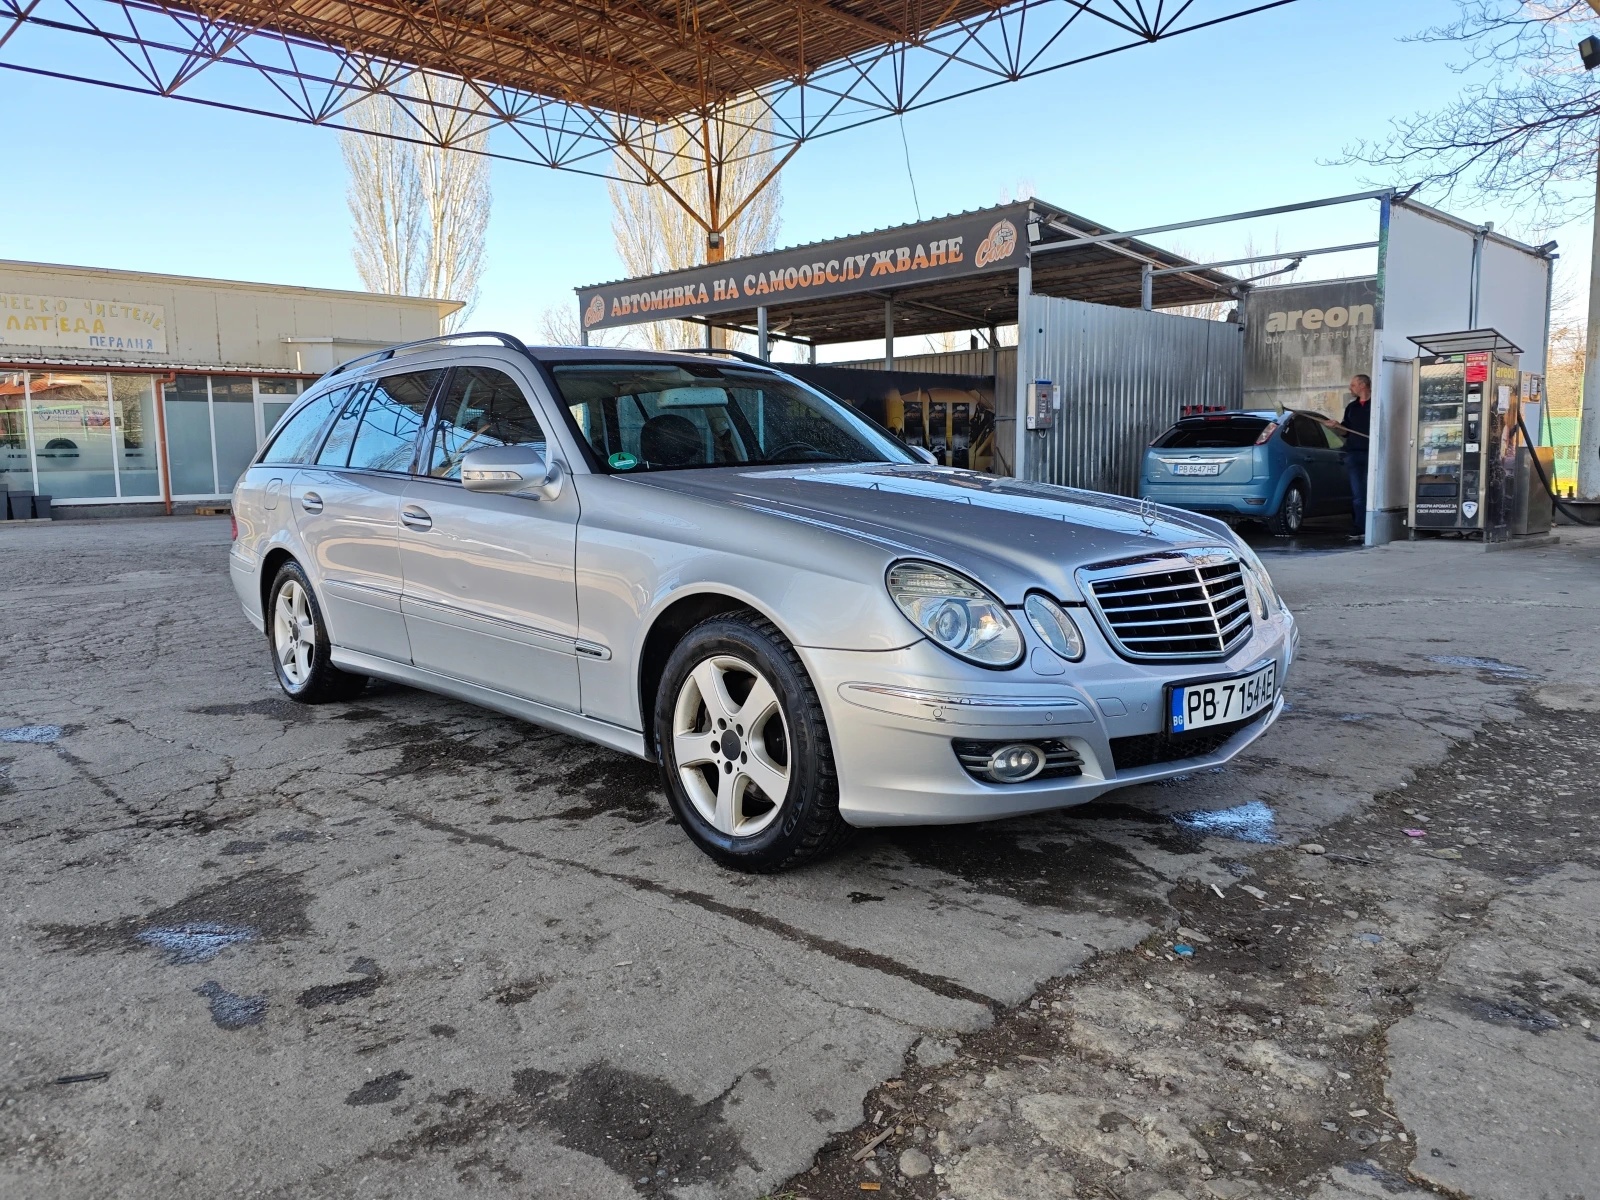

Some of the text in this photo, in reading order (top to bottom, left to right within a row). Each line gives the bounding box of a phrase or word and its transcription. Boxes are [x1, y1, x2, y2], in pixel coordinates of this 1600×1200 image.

[610, 235, 964, 317] АВТОМИВКА НА САМООБСЛУЖВАНЕ
[84, 300, 164, 331] ЧИСТЕНЕ
[1265, 303, 1375, 333] areon
[6, 315, 106, 334] ЛАТЕДА
[89, 335, 154, 350] ПЕРАЛНЯ
[1265, 333, 1309, 345] QUALITY
[1496, 366, 1517, 379] areon
[1189, 466, 1206, 474] 8647
[1187, 669, 1274, 725] PB 7154 AE
[1173, 715, 1184, 726] BG
